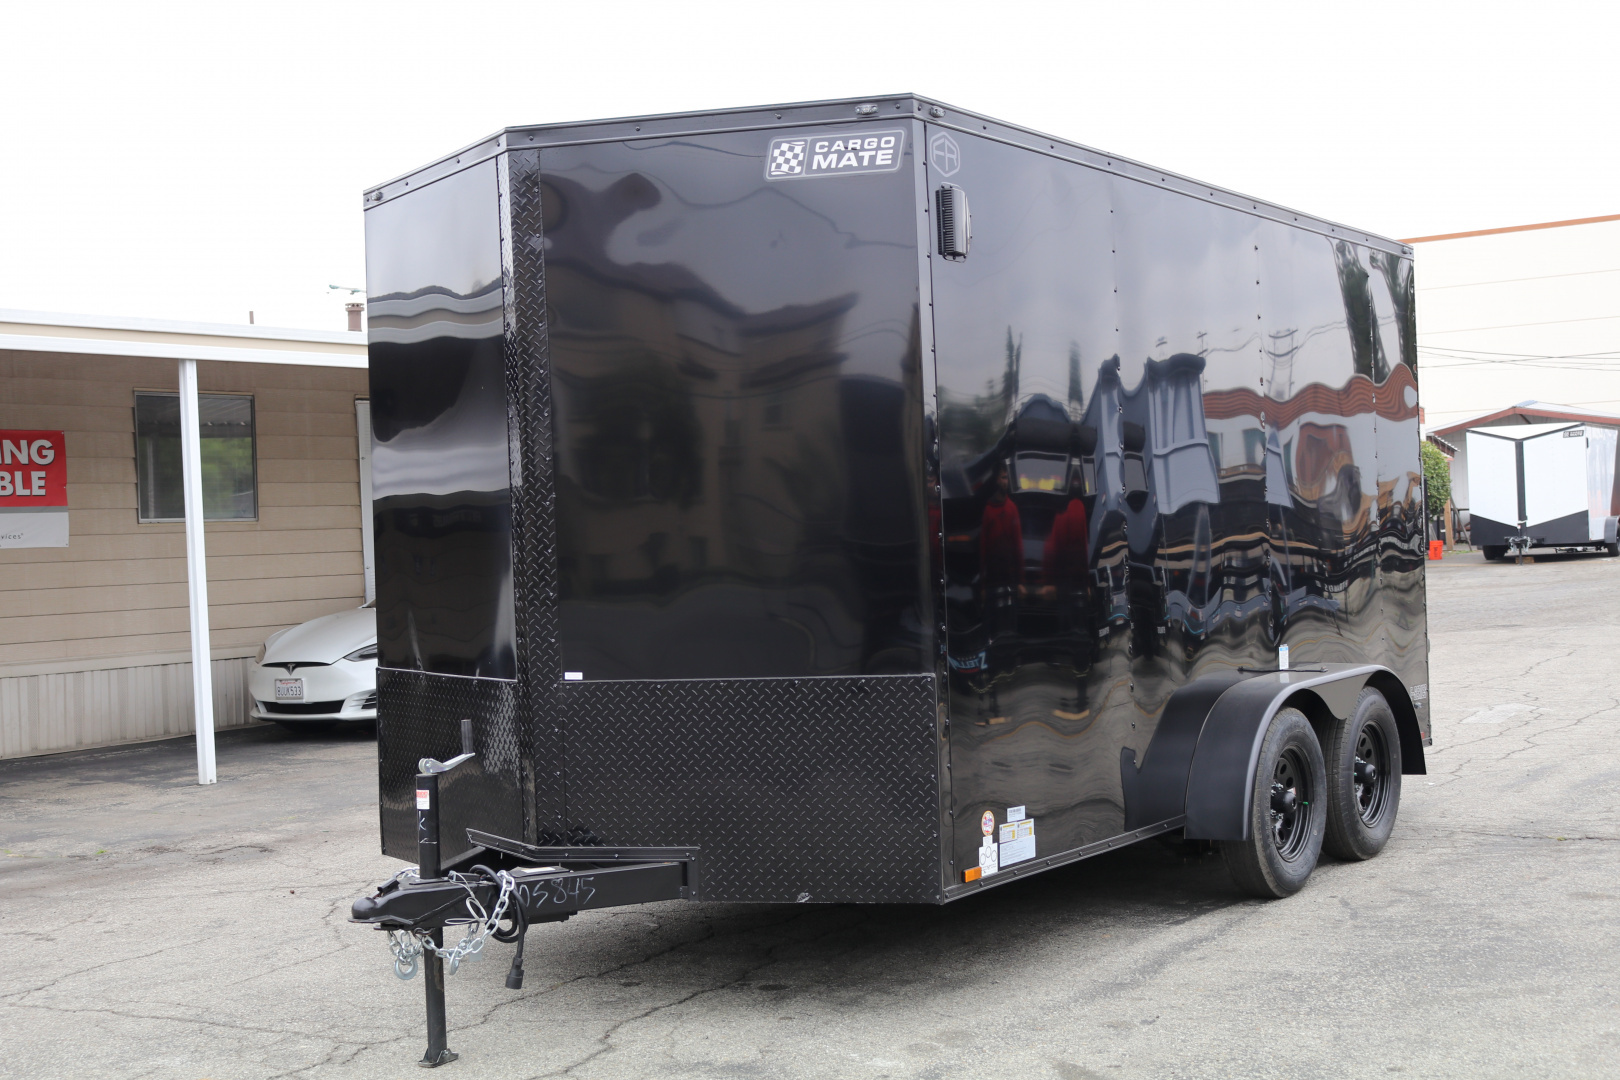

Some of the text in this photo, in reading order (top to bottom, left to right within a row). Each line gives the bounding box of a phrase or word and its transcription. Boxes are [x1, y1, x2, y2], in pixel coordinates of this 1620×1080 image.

[815, 136, 895, 153] CARGO
[812, 149, 894, 169] MATE
[0, 439, 55, 466] NG
